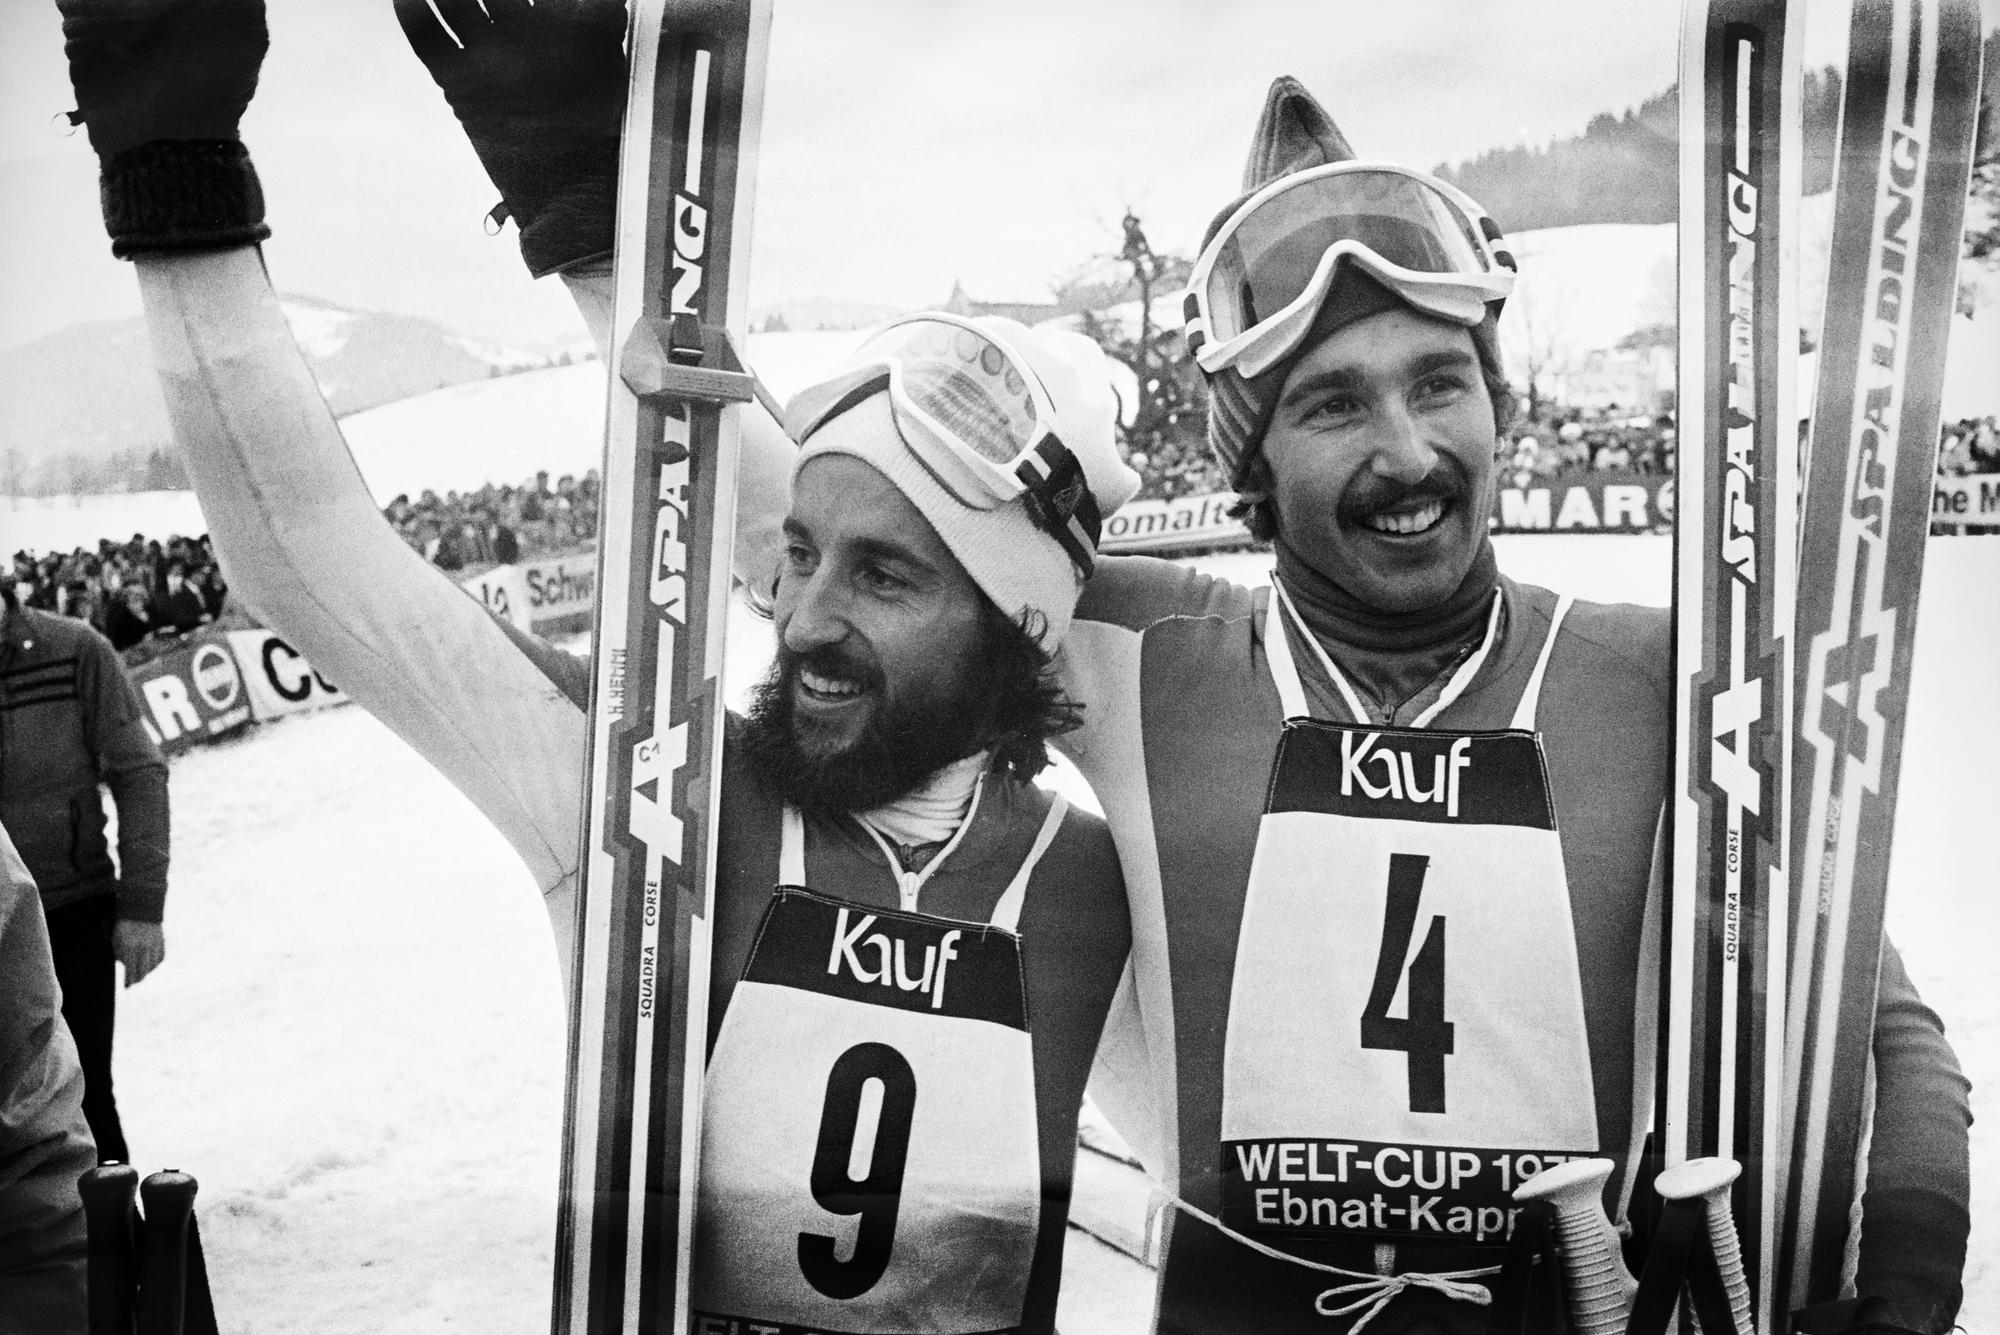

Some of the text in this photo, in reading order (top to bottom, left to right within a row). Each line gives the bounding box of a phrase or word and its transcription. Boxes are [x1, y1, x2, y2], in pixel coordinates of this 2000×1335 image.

[1850, 130, 1921, 540] SPALDING
[650, 194, 708, 625] SPALNG
[1487, 484, 1648, 528] MAR
[1341, 730, 1472, 817] Kauf
[640, 880, 658, 1018] SQUADRA CORSE
[826, 908, 961, 1009] Kauf
[1726, 828, 1740, 962] SQUADRA CORSE
[1361, 852, 1455, 1114] 4
[797, 1041, 917, 1301] 9
[1236, 1142, 1591, 1192] WELT-CUP 19
